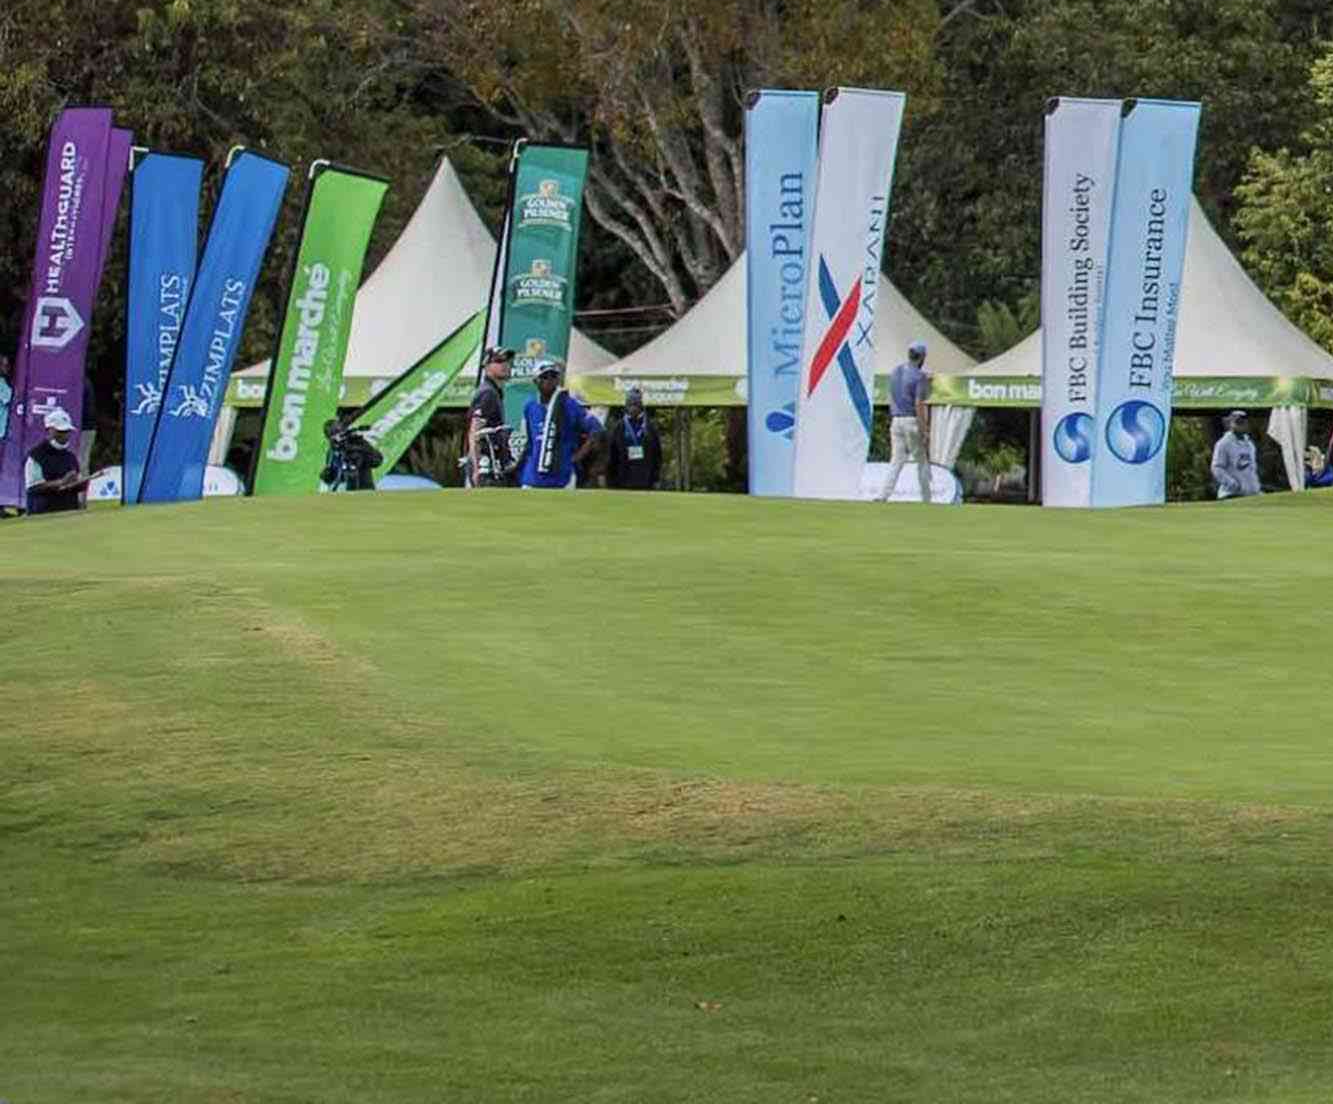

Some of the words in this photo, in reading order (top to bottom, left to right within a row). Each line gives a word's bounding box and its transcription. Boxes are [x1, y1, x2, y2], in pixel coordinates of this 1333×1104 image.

[46, 141, 77, 294] HEALTHGUARD
[1069, 173, 1096, 252] Society
[1135, 187, 1168, 324] Insurance
[769, 171, 803, 378] MicroPlan
[1068, 257, 1094, 350] Building
[200, 278, 244, 399] ZIMPLATS
[266, 394, 306, 462] bon
[287, 261, 331, 392] marché
[1068, 356, 1088, 404] FBC
[1129, 331, 1157, 389] FBC
